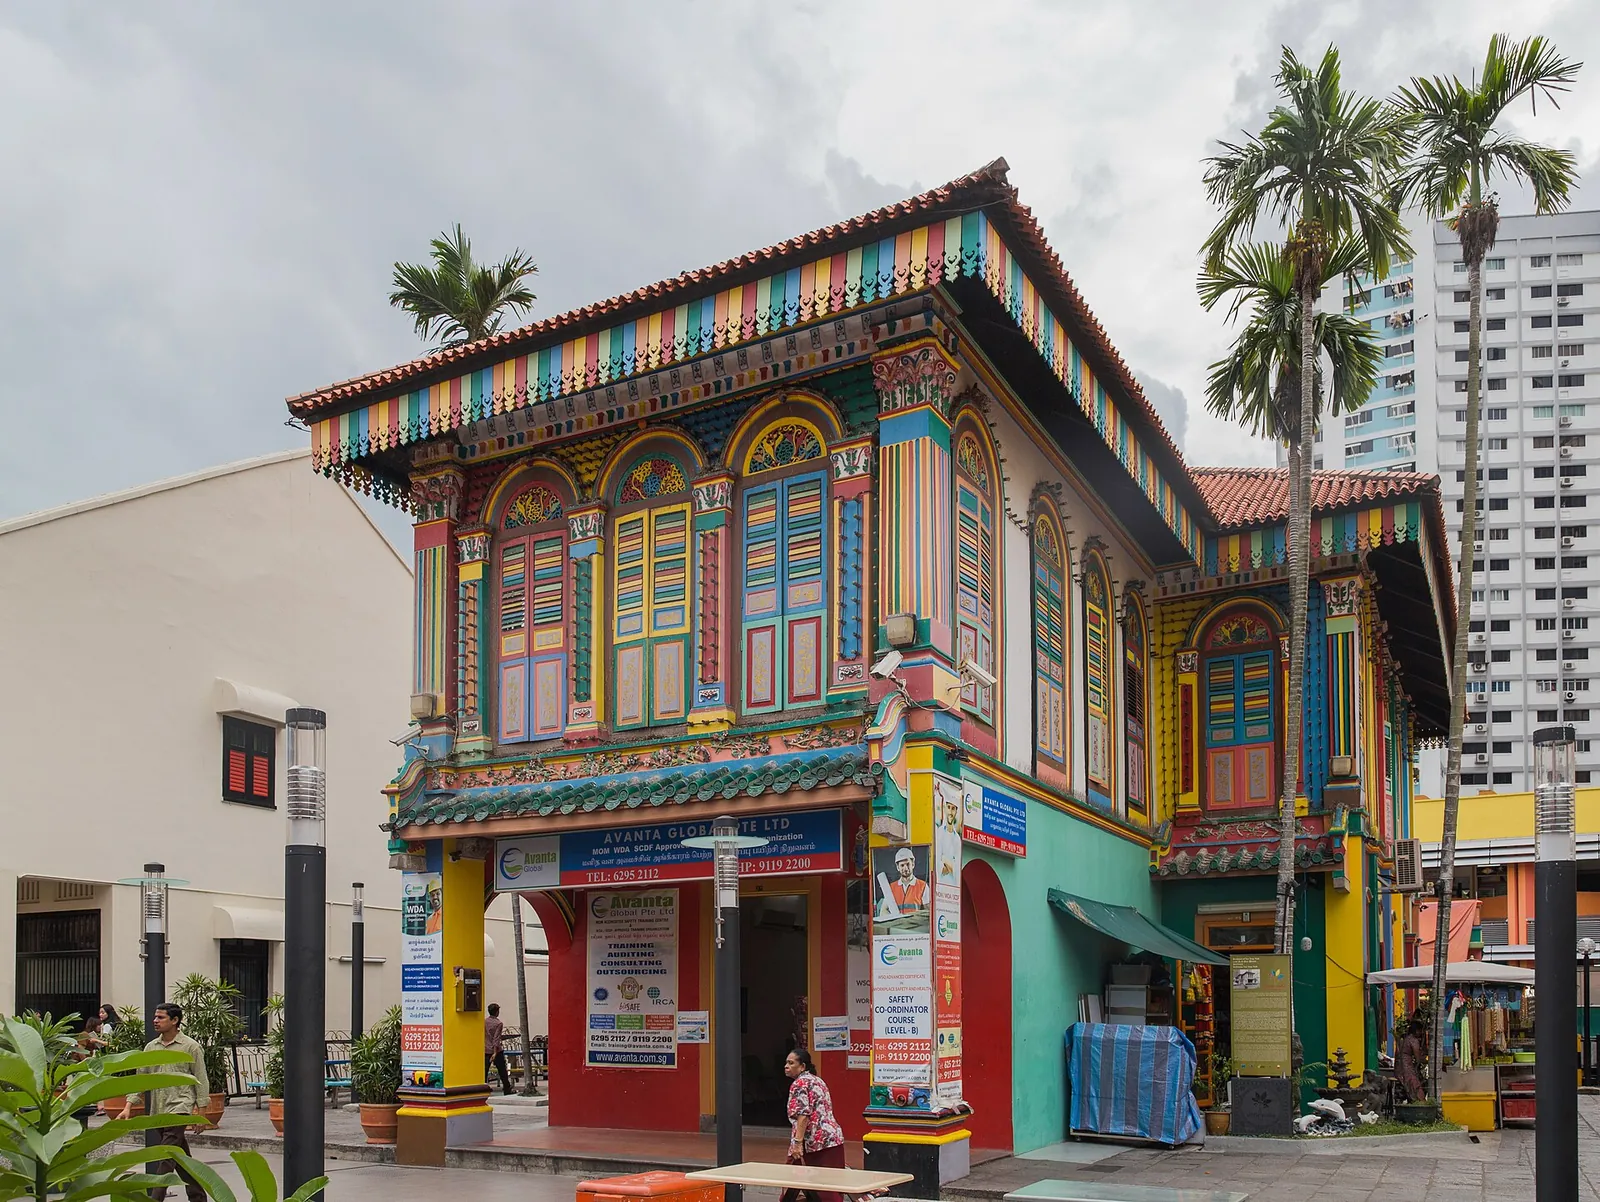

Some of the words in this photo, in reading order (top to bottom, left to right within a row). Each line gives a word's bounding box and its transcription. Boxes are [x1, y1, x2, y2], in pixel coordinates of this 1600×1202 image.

[984, 796, 998, 807] AVANTA
[604, 829, 662, 844] AVANTA
[668, 825, 714, 838] GLOBA
[764, 818, 790, 830] LTD
[966, 830, 976, 840] TEL:
[655, 842, 688, 852] Approve
[524, 851, 557, 865] Avanta
[586, 872, 611, 882] TEL:
[613, 870, 635, 881] 6295
[638, 869, 659, 879] 2112
[759, 860, 782, 871] 9119
[786, 858, 810, 870] 2200
[611, 896, 674, 909] Avanta
[407, 905, 424, 913] WDA
[885, 1026, 906, 1035] (LEVEL
[912, 1026, 918, 1035] B)
[596, 1053, 667, 1064] www.avanta.com.sg
